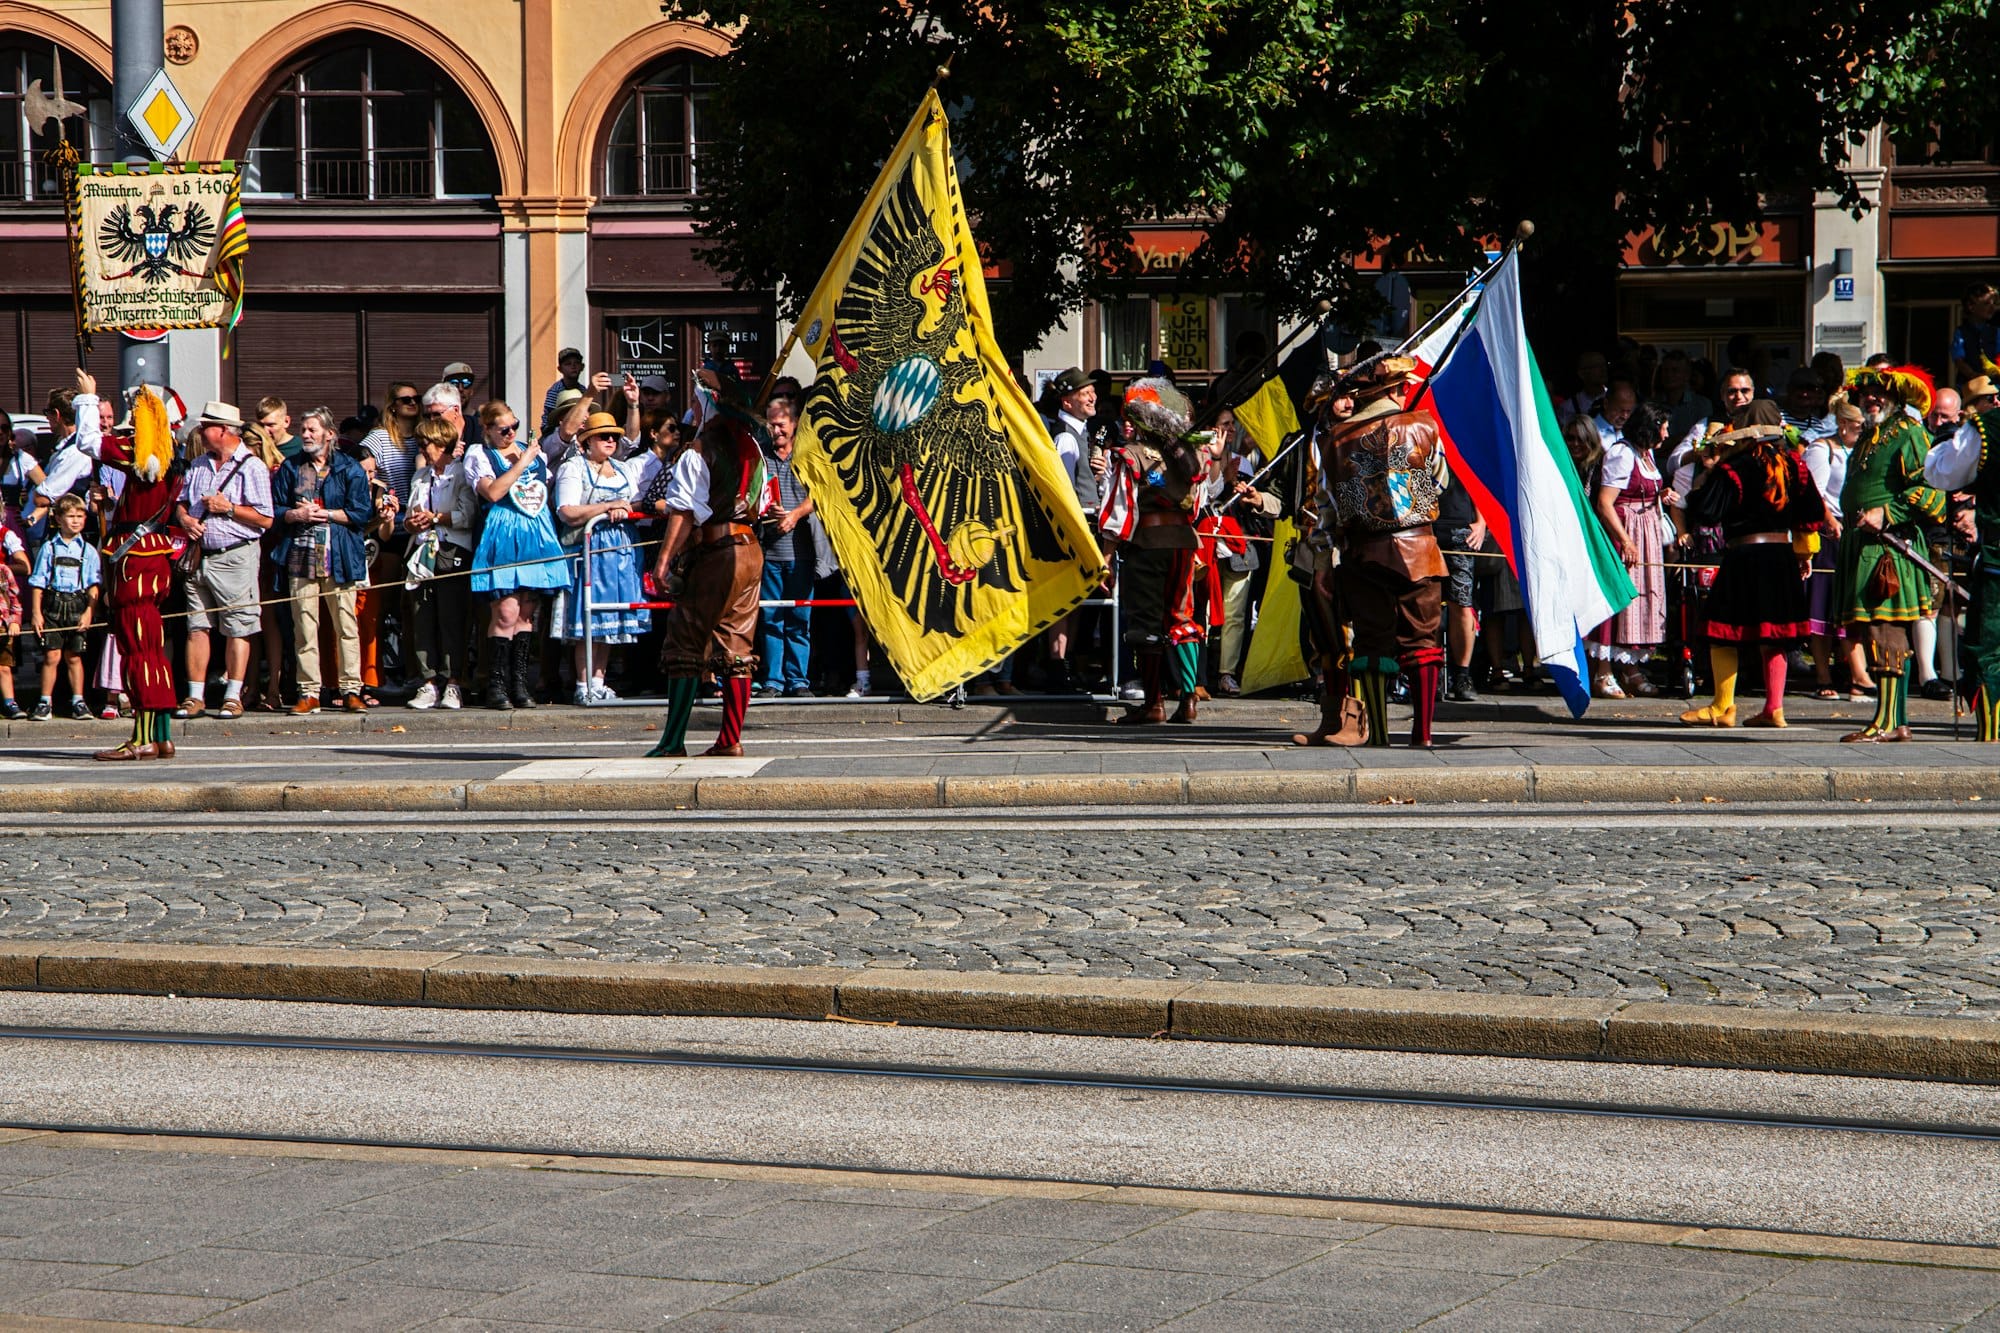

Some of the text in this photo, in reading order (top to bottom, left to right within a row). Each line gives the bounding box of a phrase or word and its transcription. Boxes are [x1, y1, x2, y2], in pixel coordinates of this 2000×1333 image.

[84, 183, 142, 198] München
[196, 178, 231, 194] 1406
[1837, 279, 1851, 291] 47
[704, 321, 729, 330] WIR
[704, 332, 758, 342] SHEN
